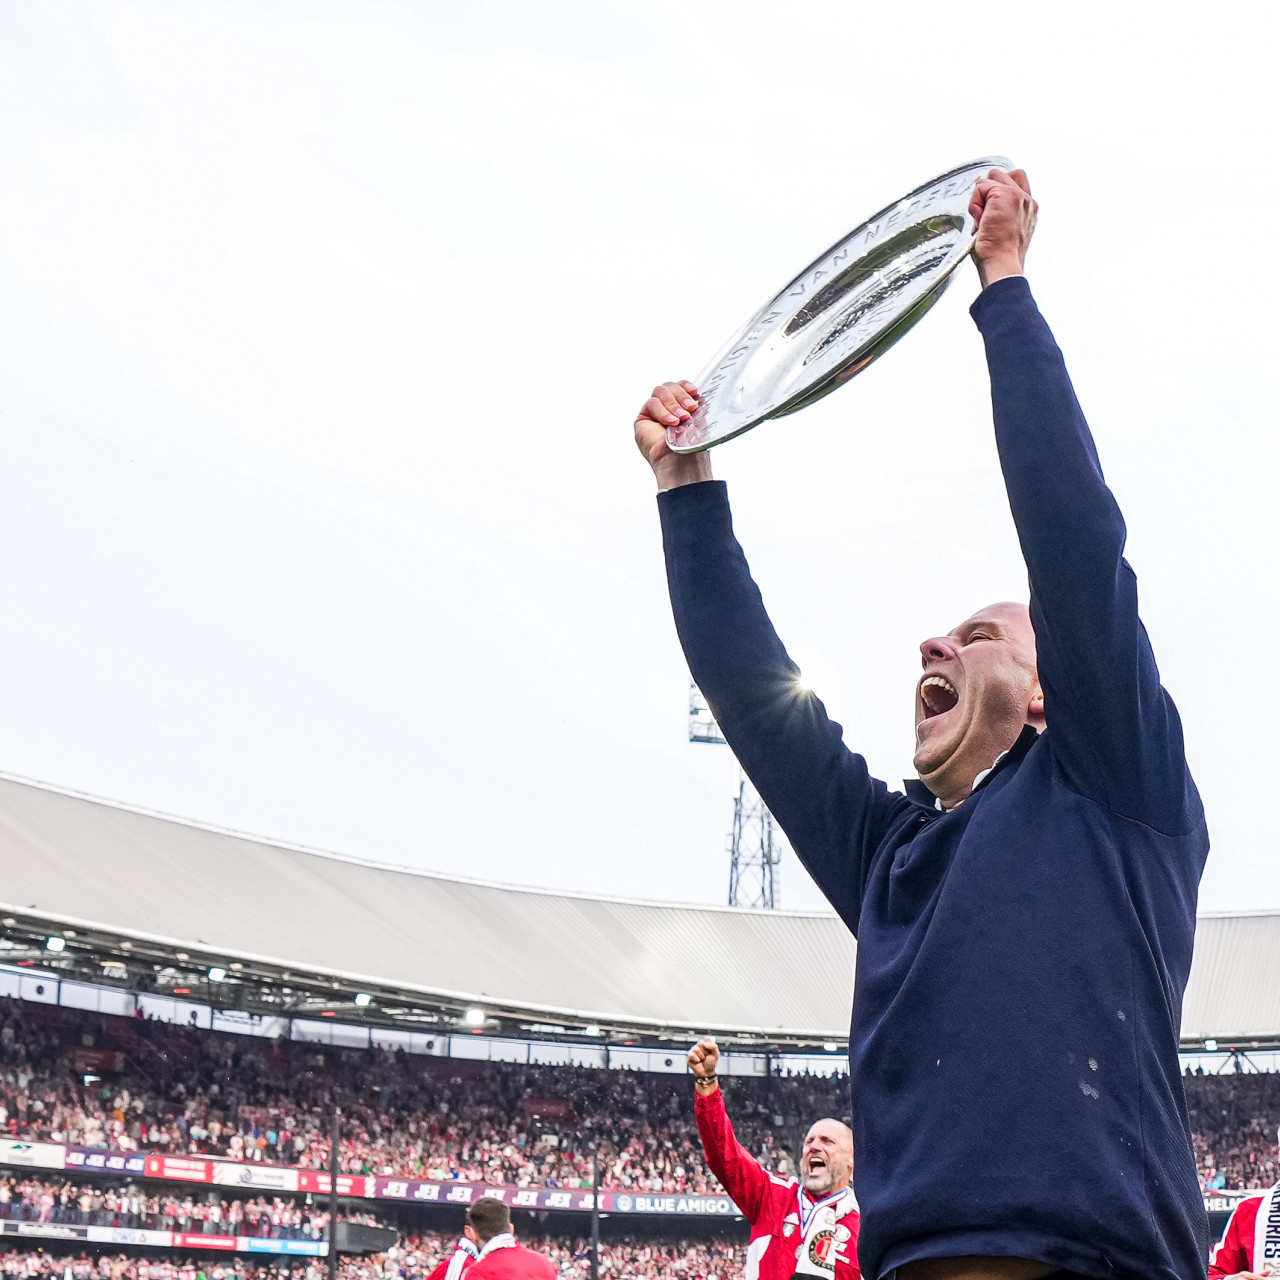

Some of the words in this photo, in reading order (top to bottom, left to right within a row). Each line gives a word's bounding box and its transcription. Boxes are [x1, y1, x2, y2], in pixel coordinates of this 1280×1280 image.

[791, 248, 848, 297] VAN
[381, 1181, 409, 1198] JEX
[414, 1184, 441, 1200] JEX
[446, 1186, 473, 1202] JEX
[511, 1191, 539, 1206] JEX
[545, 1192, 572, 1208] JEX
[635, 1197, 675, 1212] BLUE
[676, 1198, 730, 1214] AMIGO
